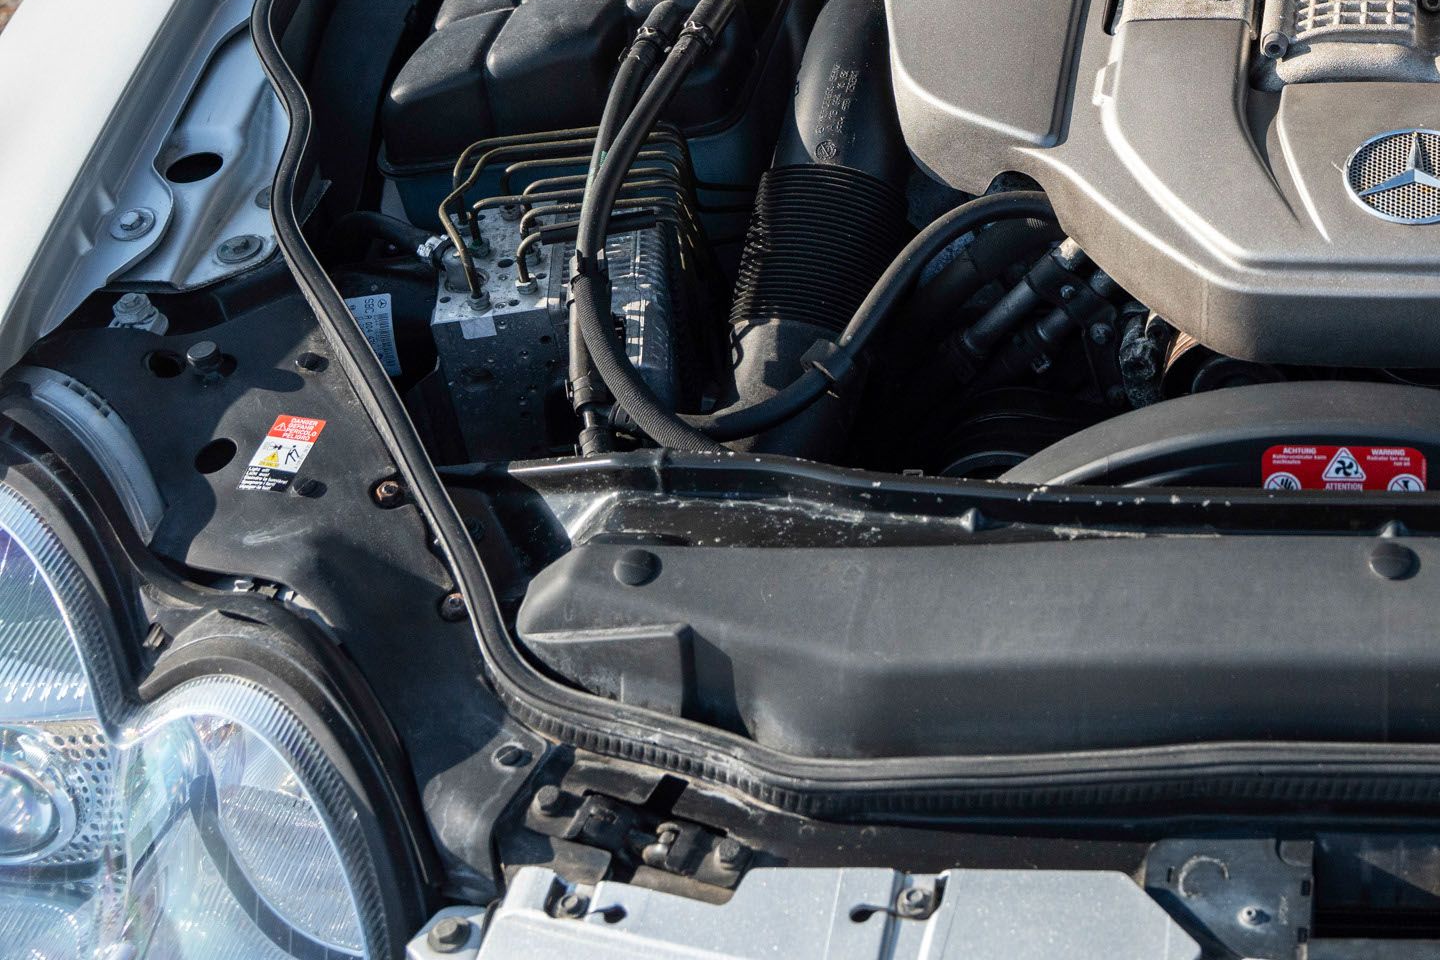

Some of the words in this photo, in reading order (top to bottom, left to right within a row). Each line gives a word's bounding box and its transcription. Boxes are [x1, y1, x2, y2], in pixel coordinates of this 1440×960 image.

[291, 417, 319, 427] DANGER
[285, 428, 317, 437] PERICOLO
[282, 433, 311, 441] PELIGRO
[1371, 448, 1405, 456] WARNING
[1325, 483, 1363, 491] ATTENTION
